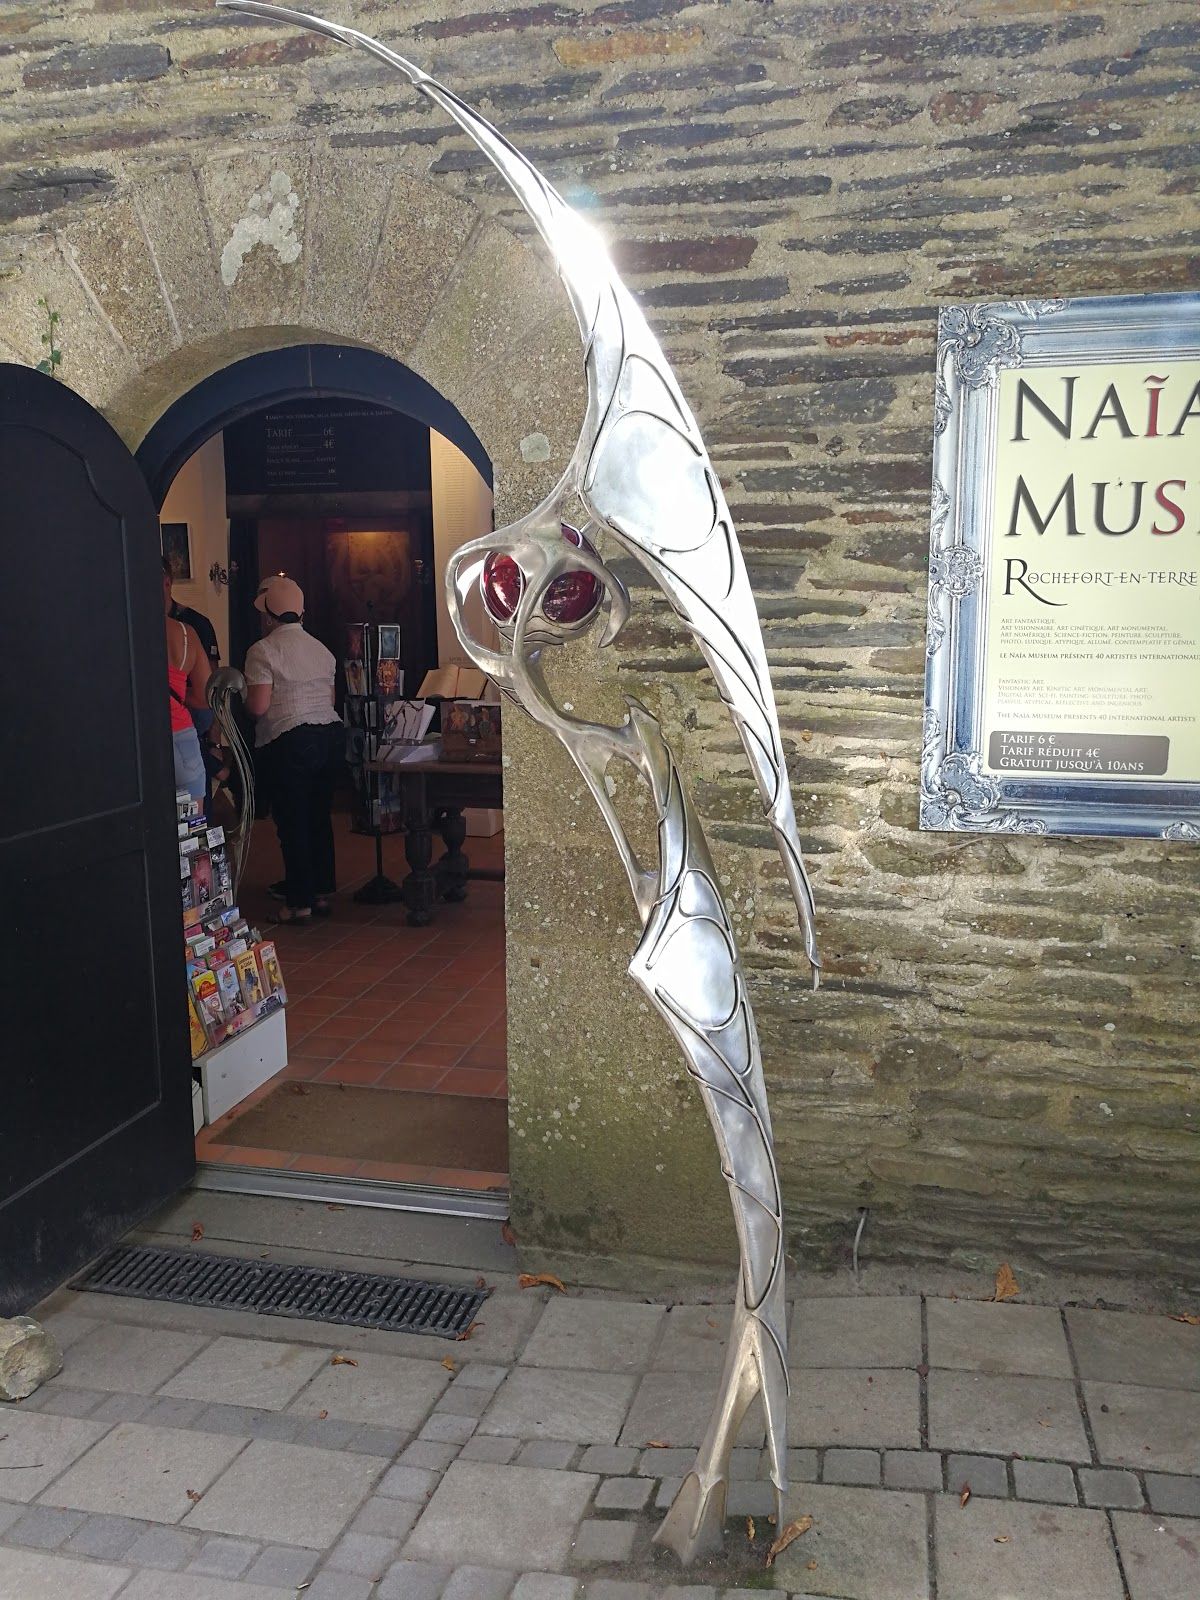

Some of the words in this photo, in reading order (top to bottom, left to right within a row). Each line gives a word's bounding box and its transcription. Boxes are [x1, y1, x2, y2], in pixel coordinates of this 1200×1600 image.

[1005, 473, 1200, 537] MUS
[1000, 733, 1035, 744] TARIF
[1038, 735, 1045, 744] 6
[1048, 735, 1056, 744] €
[1000, 745, 1034, 756] TARIF
[1038, 746, 1082, 758] RÉDUIT
[1085, 748, 1100, 758] 4€
[1000, 757, 1052, 768] GRATUIT
[1055, 759, 1103, 772] JUSQU'À
[1107, 761, 1144, 771] 10ANS
